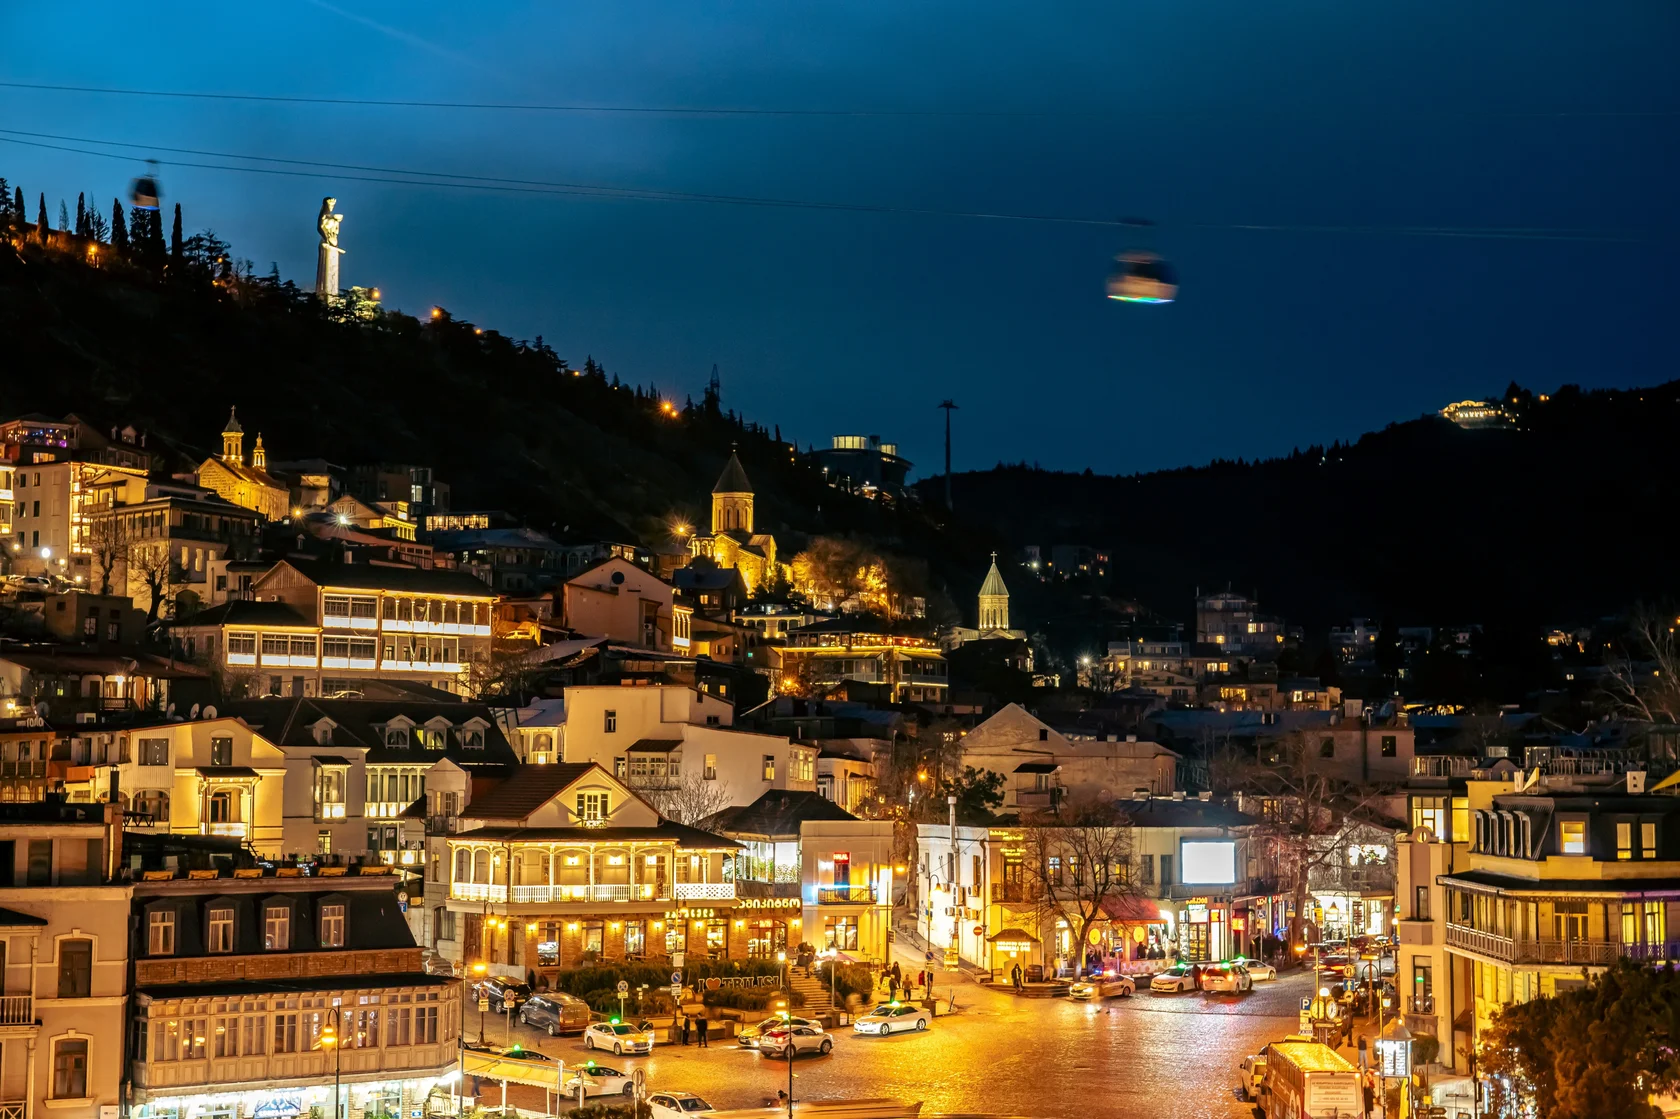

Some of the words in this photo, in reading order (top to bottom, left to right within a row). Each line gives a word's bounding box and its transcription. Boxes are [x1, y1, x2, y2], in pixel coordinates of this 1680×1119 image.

[731, 898, 801, 909] ამიკიტნო
[698, 978, 705, 993] I
[722, 976, 779, 989] TBILISI
[1302, 998, 1310, 1010] P
